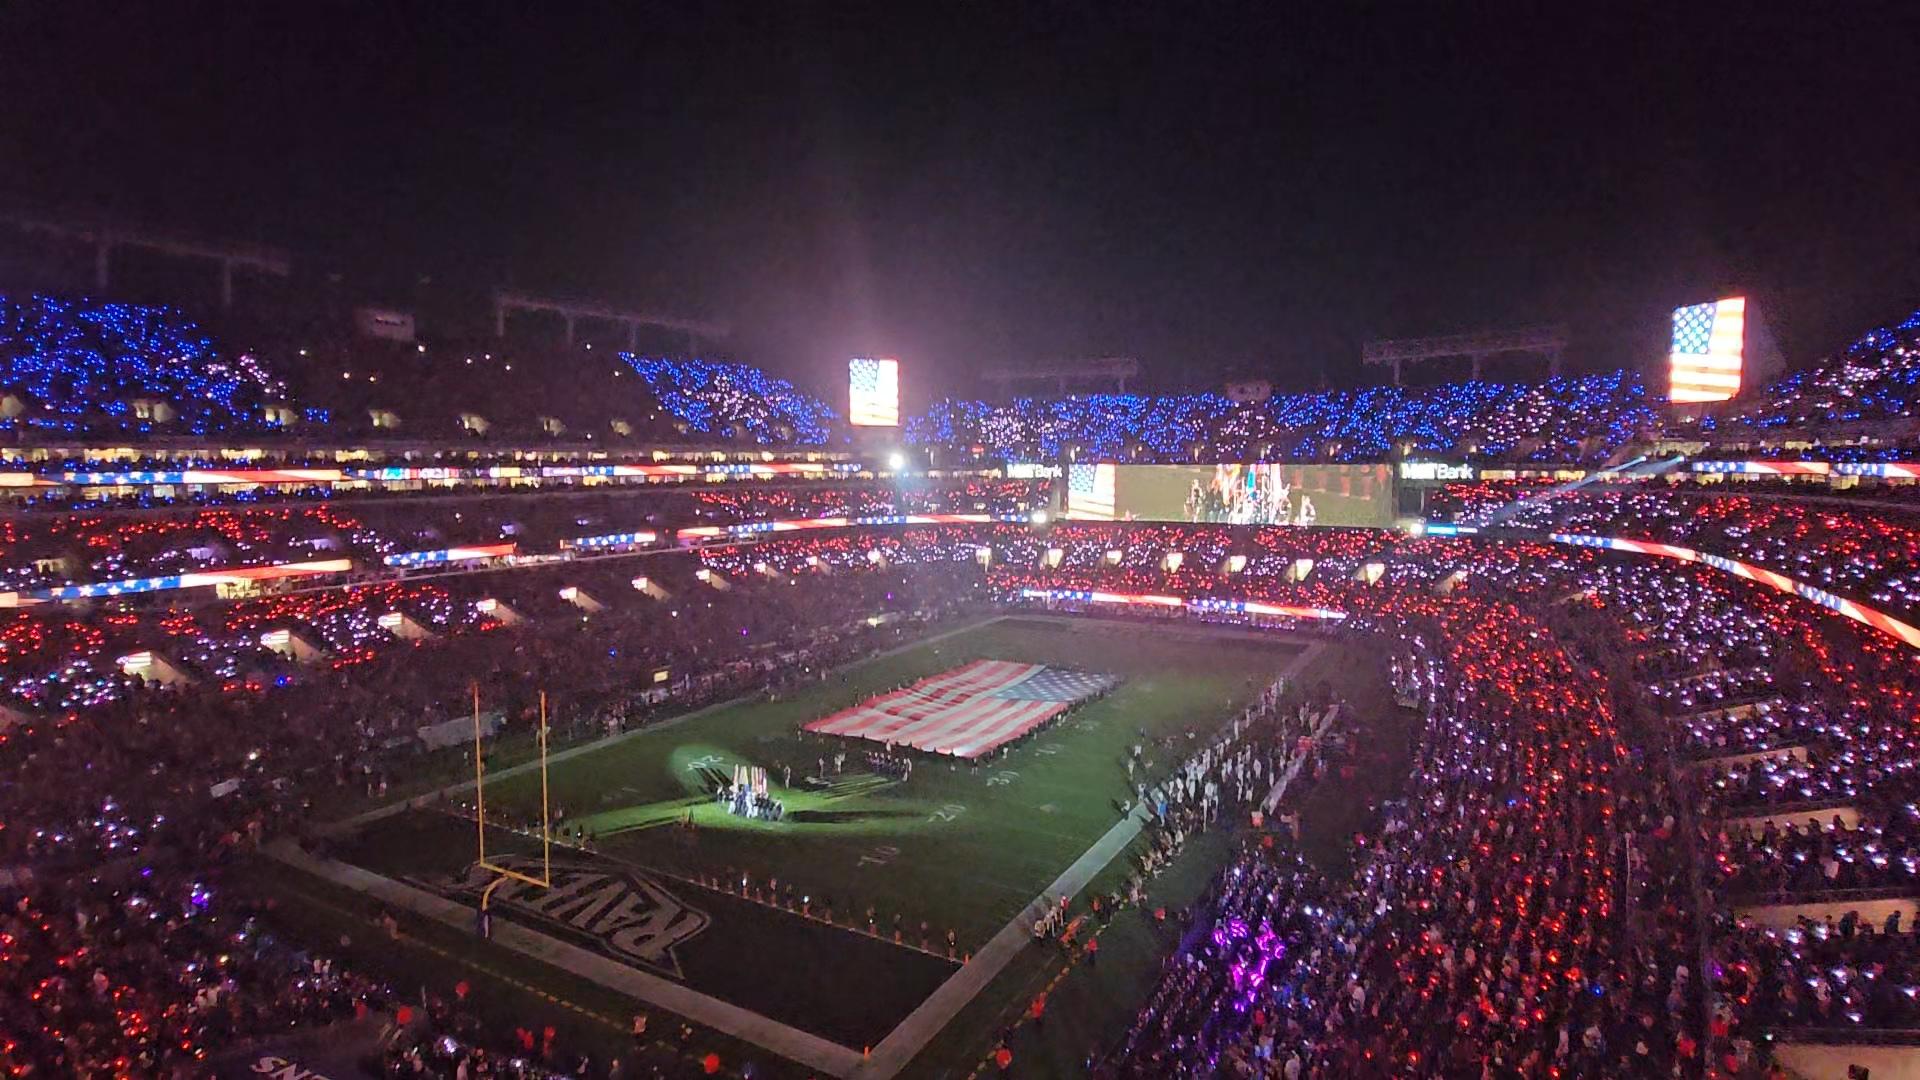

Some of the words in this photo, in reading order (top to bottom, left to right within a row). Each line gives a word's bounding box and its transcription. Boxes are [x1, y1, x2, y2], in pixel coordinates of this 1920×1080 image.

[1035, 464, 1062, 479] Bank
[1438, 463, 1473, 479] Bank
[927, 804, 966, 822] 20
